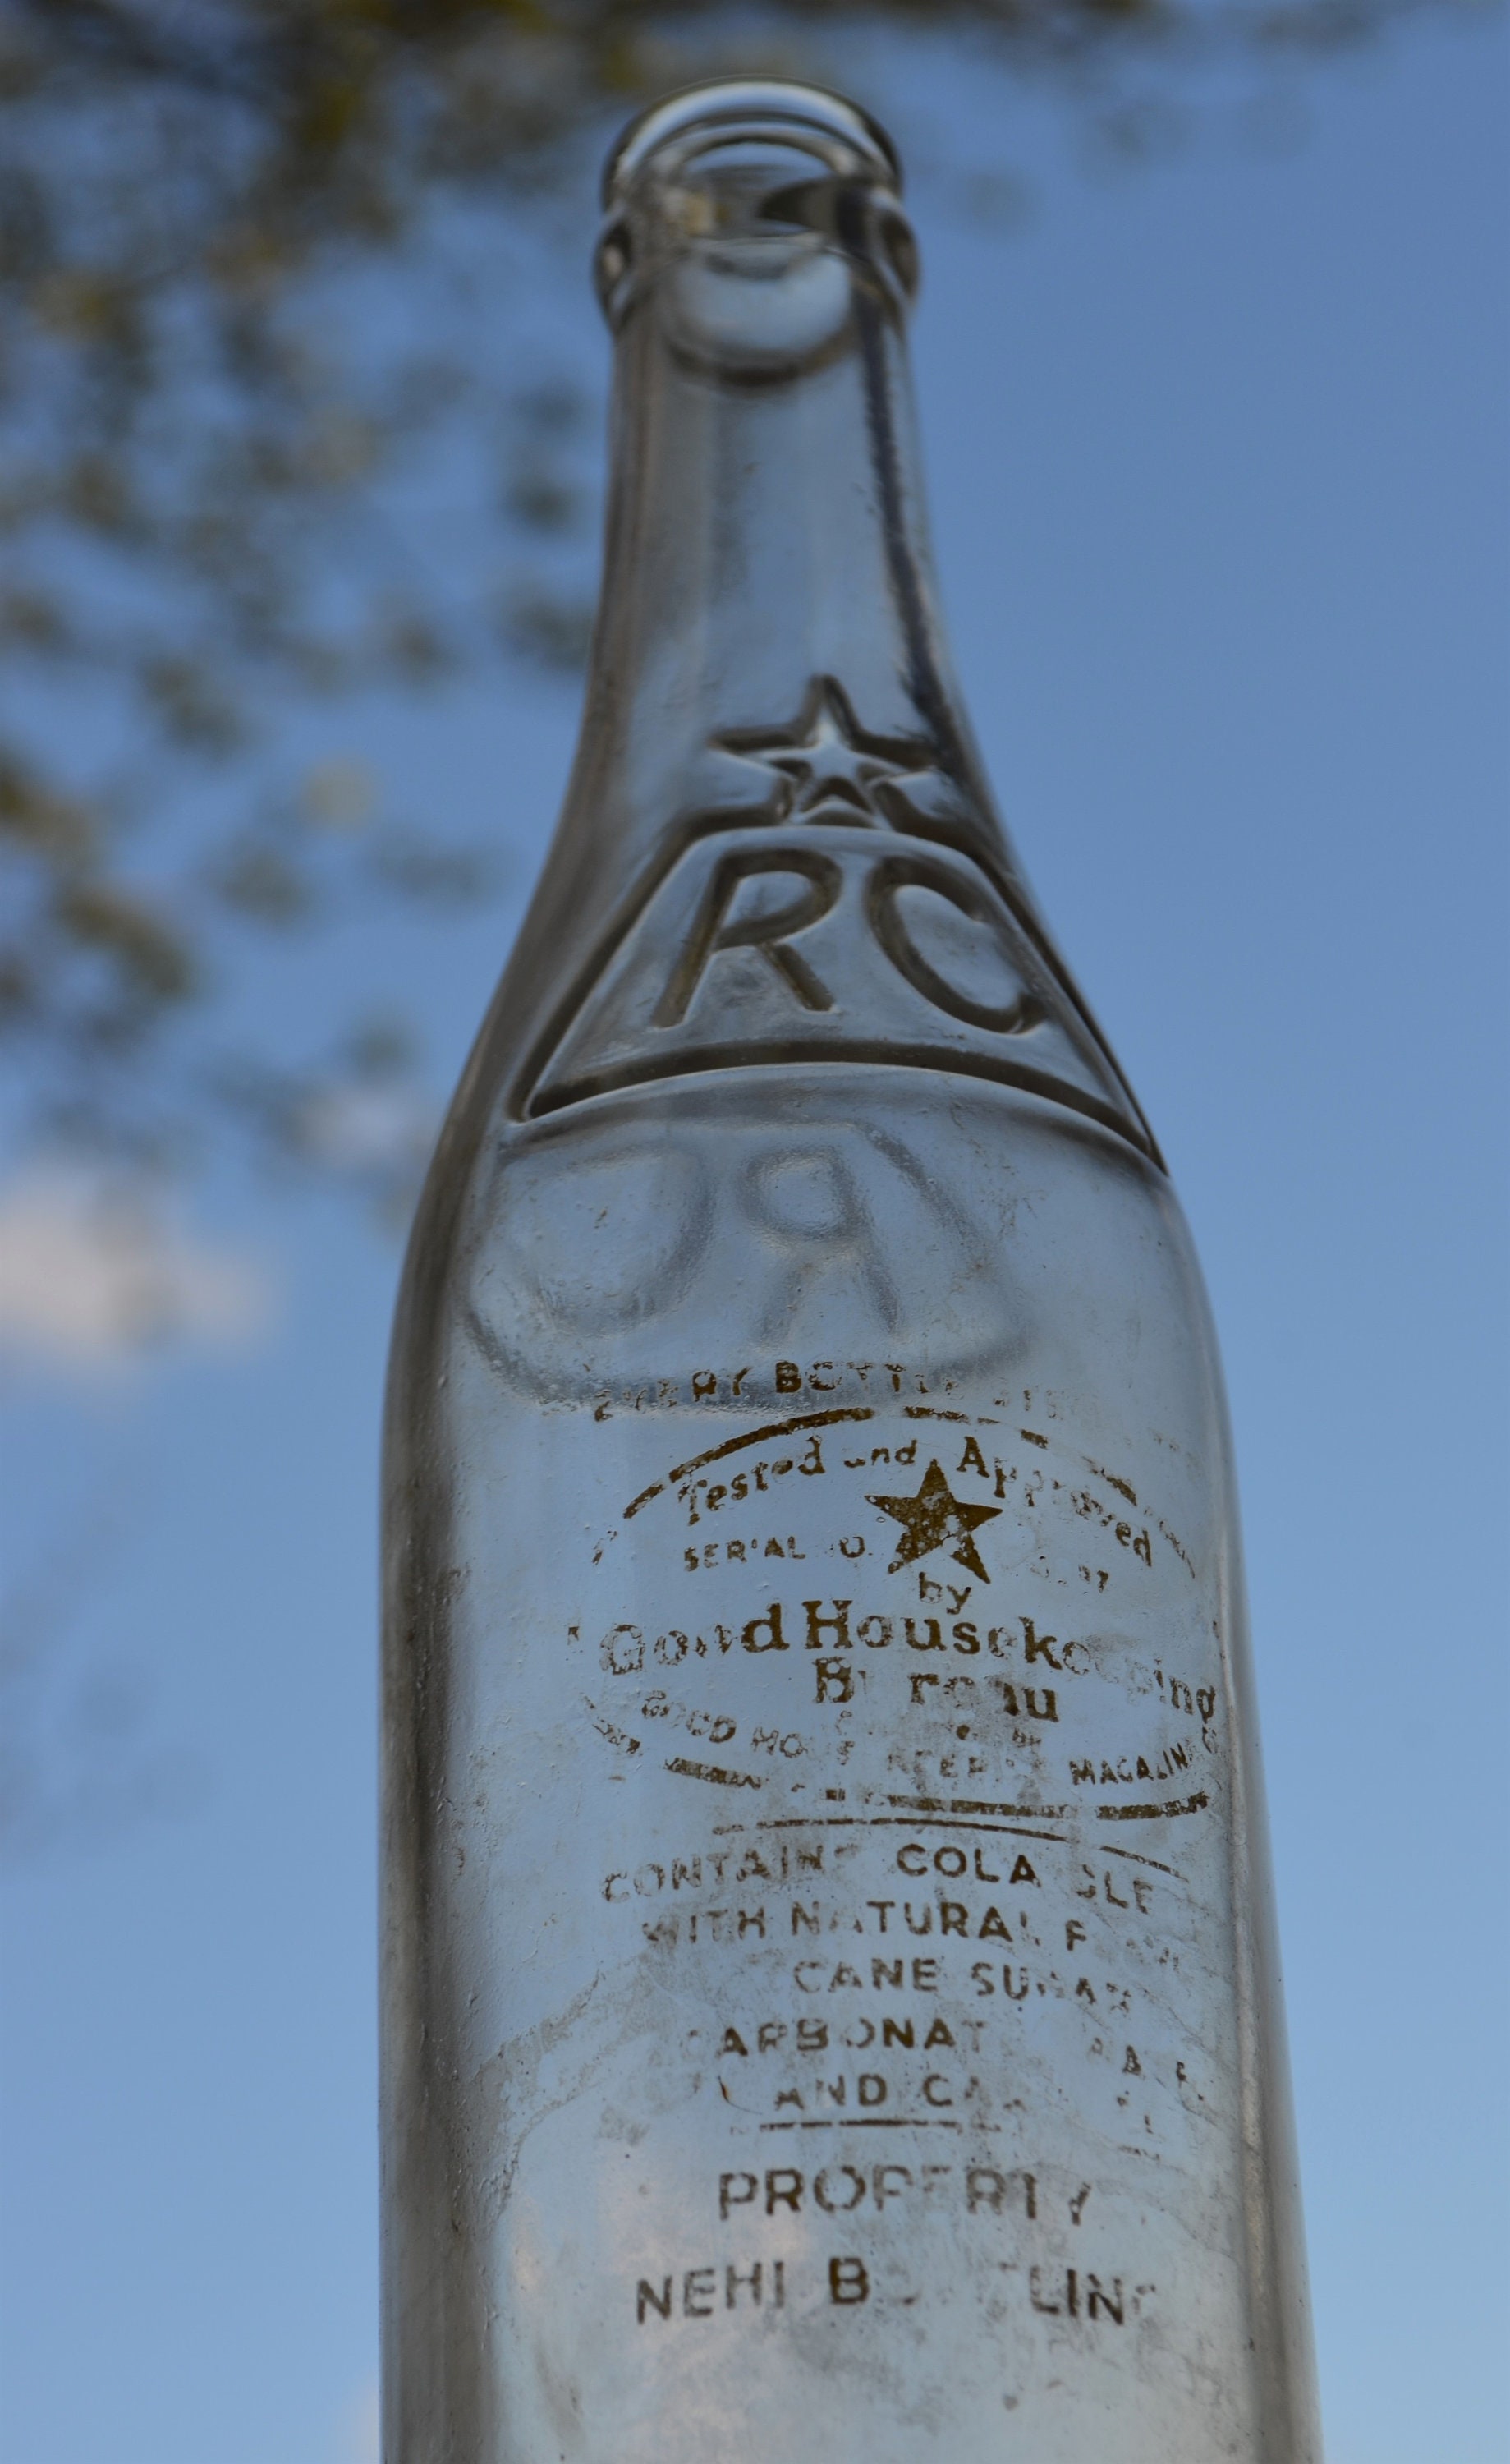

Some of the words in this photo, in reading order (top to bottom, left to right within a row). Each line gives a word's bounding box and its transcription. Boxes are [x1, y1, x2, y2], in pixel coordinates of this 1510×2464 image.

[651, 846, 1046, 1038] RC
[918, 1570, 972, 1615] by
[812, 1656, 1059, 1722] Breau
[897, 1842, 1041, 1888] COLA
[793, 1957, 938, 1993] CANE
[636, 2260, 785, 2326] NEHI
